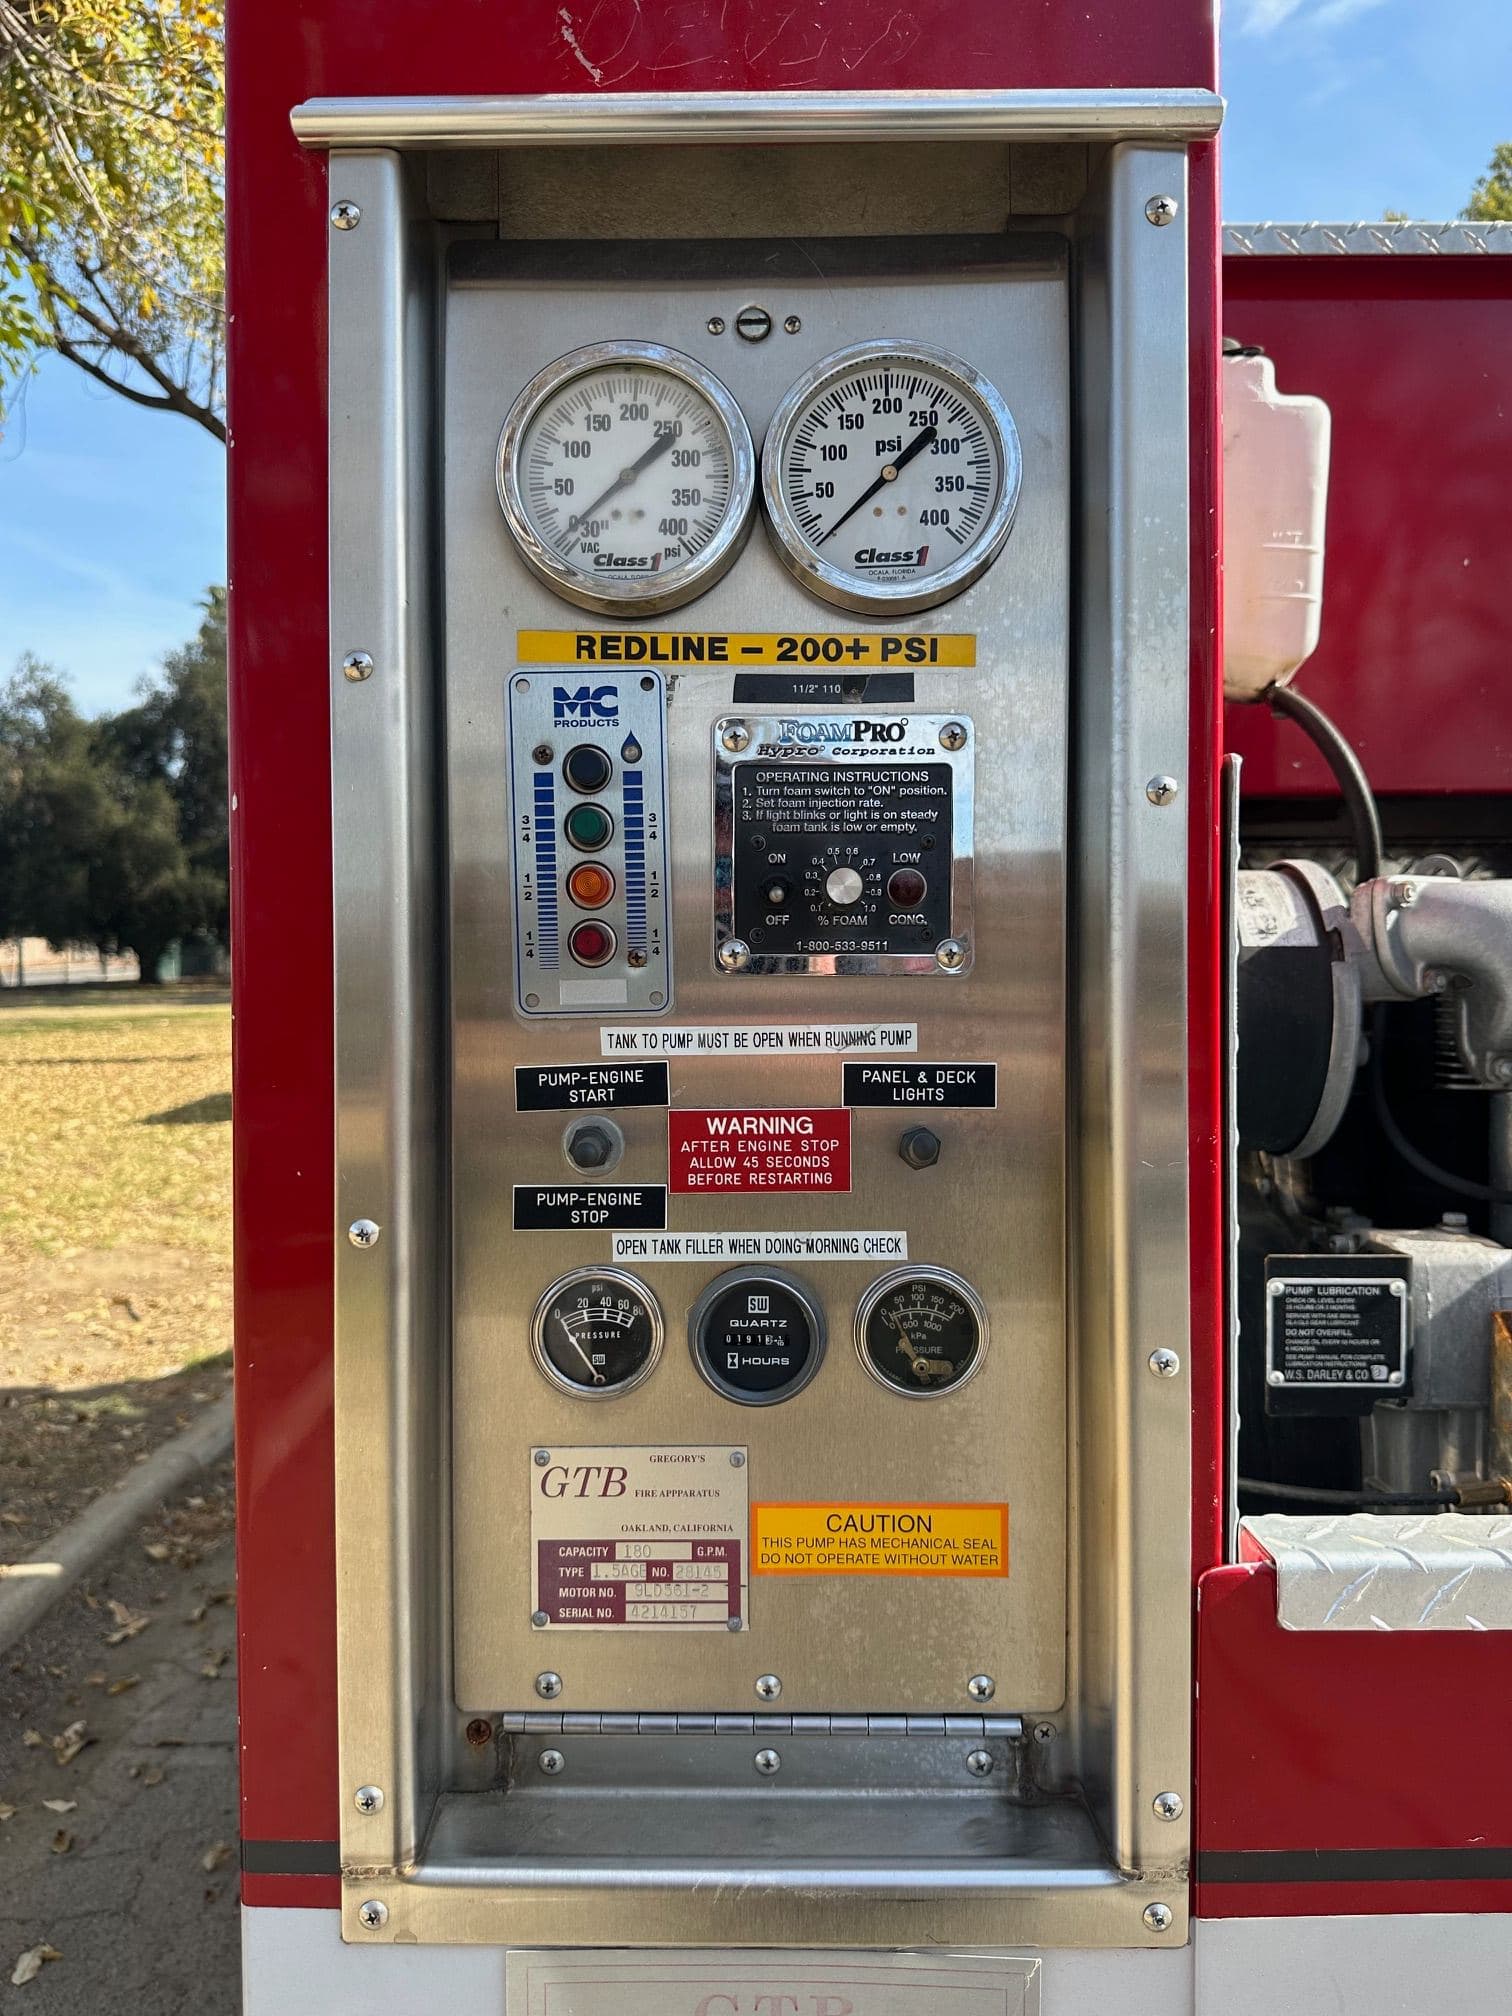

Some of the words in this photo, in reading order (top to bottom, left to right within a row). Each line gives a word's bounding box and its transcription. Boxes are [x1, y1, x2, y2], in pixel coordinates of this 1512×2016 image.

[872, 398, 902, 414] 200
[620, 404, 648, 421] 200
[909, 410, 938, 427] 250
[585, 414, 611, 432] 150
[838, 414, 864, 430] 150
[654, 420, 682, 438] 250
[563, 441, 590, 458] 100
[876, 436, 902, 456] psi
[930, 438, 960, 454] 300
[672, 450, 700, 467] 300
[820, 444, 848, 461] 100
[555, 478, 574, 496] 50
[816, 482, 834, 498] 50
[935, 476, 964, 492] 350
[672, 489, 700, 506] 350
[920, 510, 950, 526] 400
[658, 518, 688, 536] 400
[581, 542, 600, 554] VAC
[664, 545, 680, 560] psi
[576, 635, 728, 660] REDLINE
[776, 637, 868, 662] 200+
[881, 638, 938, 662] PSI
[822, 684, 841, 694] 110
[553, 686, 618, 718] MC
[554, 719, 620, 728] PRODUCTS
[832, 746, 936, 756] Corporation
[756, 772, 830, 782] OPERATING
[834, 771, 928, 782] INSTRUCTIONS
[756, 786, 780, 796] Turn
[784, 786, 811, 796] foam
[814, 786, 850, 796] switch
[854, 787, 865, 796] to
[868, 786, 896, 796] "ON"
[900, 786, 947, 798] position.
[742, 799, 752, 808] 2.
[756, 798, 776, 808] Set
[778, 798, 806, 808] foam
[808, 798, 855, 810] injection
[858, 799, 884, 808] rate.
[756, 810, 763, 820] If
[766, 810, 790, 822] light
[794, 810, 826, 820] blinks
[830, 812, 840, 820] or
[844, 810, 867, 822] light
[870, 810, 880, 819] is
[883, 811, 897, 820] on
[900, 810, 938, 822] steady
[772, 823, 800, 832] foam
[804, 823, 828, 832] tank
[830, 823, 840, 832] is
[843, 823, 862, 832] low
[866, 824, 877, 832] or
[880, 823, 917, 834] empty.
[768, 854, 786, 864] ON
[812, 857, 824, 866] 0.4
[863, 858, 876, 866] 0.7
[892, 853, 921, 863] LOW
[805, 872, 818, 880] 0.3
[804, 888, 816, 896] 0.2
[766, 915, 790, 925] OFF
[818, 915, 829, 925] %
[832, 915, 868, 925] FOAM
[888, 915, 928, 926] CONC.
[796, 941, 888, 951] 1-800-533-9511
[608, 1034, 637, 1049] TANK
[642, 1034, 657, 1049] TO
[662, 1033, 693, 1049] PUMP
[698, 1033, 729, 1048] MUST
[734, 1033, 748, 1048] BE
[753, 1032, 783, 1048] OPEN
[788, 1031, 821, 1047] WHEN
[826, 1030, 876, 1047] RUNNING
[881, 1030, 912, 1046] PUMP
[538, 1070, 644, 1086] PUMP-ENGINE
[862, 1071, 910, 1084] PANEL
[918, 1071, 928, 1084] &
[936, 1071, 976, 1084] DECK
[569, 1088, 616, 1102] START
[893, 1088, 945, 1101] LIGHTS
[707, 1117, 813, 1134] WARNING
[681, 1141, 730, 1152] AFTER
[738, 1141, 792, 1152] ENGINE
[801, 1140, 839, 1151] STOP
[690, 1157, 737, 1168] ALLOW
[743, 1157, 759, 1168] 45
[766, 1156, 830, 1168] SECONDS
[688, 1173, 742, 1185] BEFORE
[749, 1173, 832, 1184] RESTARTING
[537, 1192, 642, 1206] PUMP-ENGINE
[571, 1210, 609, 1223] STOP
[616, 1239, 647, 1254] OPEN
[652, 1239, 681, 1254] TANK
[686, 1239, 724, 1254] FILLER
[729, 1239, 761, 1254] WHEN
[765, 1238, 801, 1253] DOING
[806, 1238, 859, 1253] MORNING
[864, 1238, 902, 1253] CHECK
[1285, 1287, 1313, 1295] PUMP
[1317, 1287, 1380, 1295] LUBRICATION
[577, 1298, 588, 1308] 20
[600, 1297, 611, 1307] 40
[618, 1300, 629, 1309] 60
[555, 1309, 560, 1319] 0
[633, 1305, 644, 1316] 80
[730, 1320, 787, 1328] QUARTZ
[576, 1331, 620, 1339] PRESSURE
[1307, 1369, 1344, 1379] DARLEY
[650, 1455, 706, 1463] GREGORY'S
[540, 1466, 628, 1498] GTB
[621, 1524, 672, 1533] OAKLAND,
[674, 1524, 733, 1532] CALIFORNIA
[826, 1514, 932, 1532] CAUTION
[762, 1537, 792, 1548] THIS
[797, 1537, 835, 1548] PUMP
[839, 1537, 866, 1549] HAS
[871, 1538, 959, 1549] MECHANICAL
[963, 1538, 997, 1549] SEAL
[559, 1547, 608, 1557] CAPACITY
[624, 1544, 651, 1558] 180
[697, 1546, 727, 1556] G.P.M.
[761, 1553, 780, 1564] DO
[785, 1553, 813, 1564] NOT
[816, 1553, 880, 1564] OPERATE
[885, 1554, 947, 1565] WITHOUT
[951, 1554, 999, 1565] WATER
[559, 1567, 584, 1577] TYPE
[652, 1567, 670, 1577] NO.
[559, 1588, 597, 1597] MOTOR
[599, 1588, 616, 1597] NO.
[559, 1608, 595, 1618] SERIAL
[597, 1608, 614, 1618] NO.
